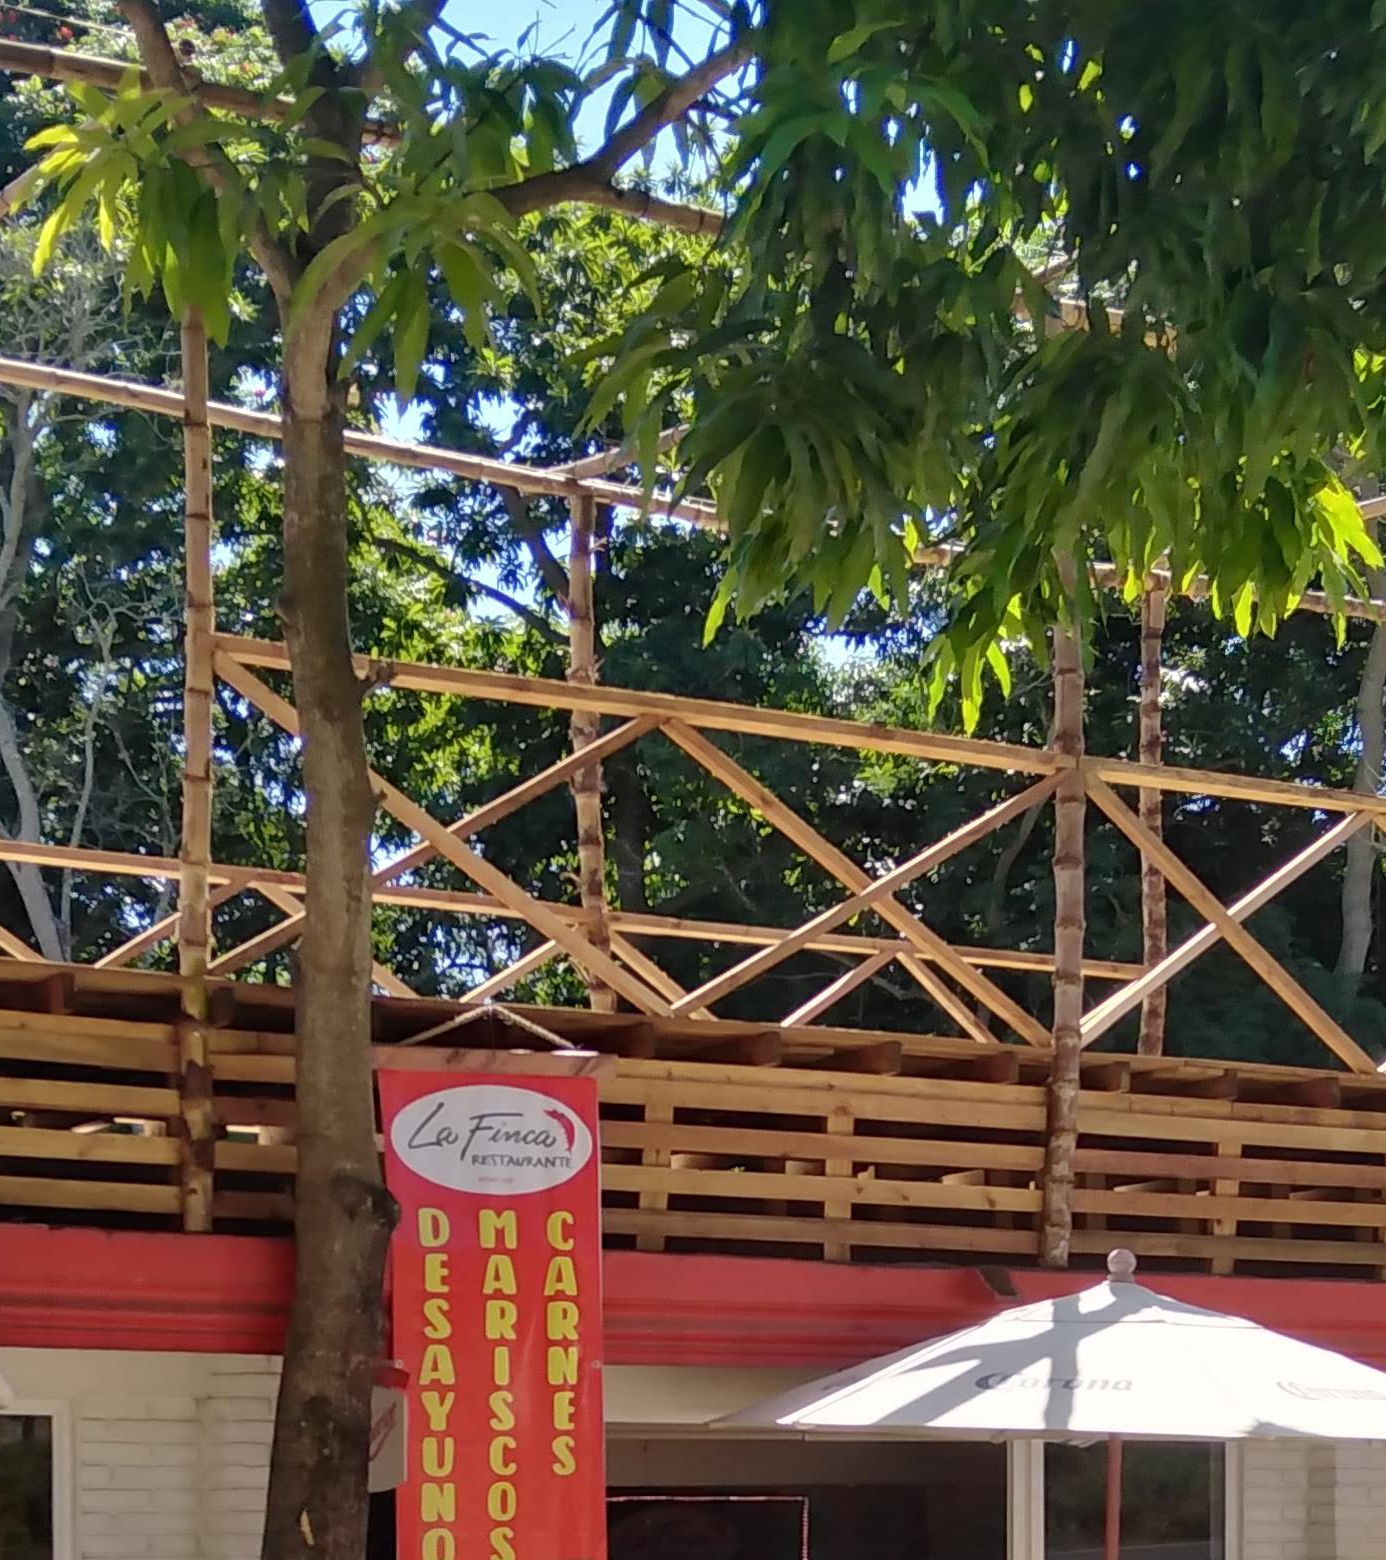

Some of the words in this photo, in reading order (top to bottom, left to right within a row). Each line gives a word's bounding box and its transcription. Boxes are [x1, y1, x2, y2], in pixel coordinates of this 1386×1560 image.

[407, 1101, 459, 1150] La
[459, 1112, 557, 1162] Finca
[471, 1153, 573, 1169] RESTAURANTE
[543, 1210, 580, 1477] CARNES
